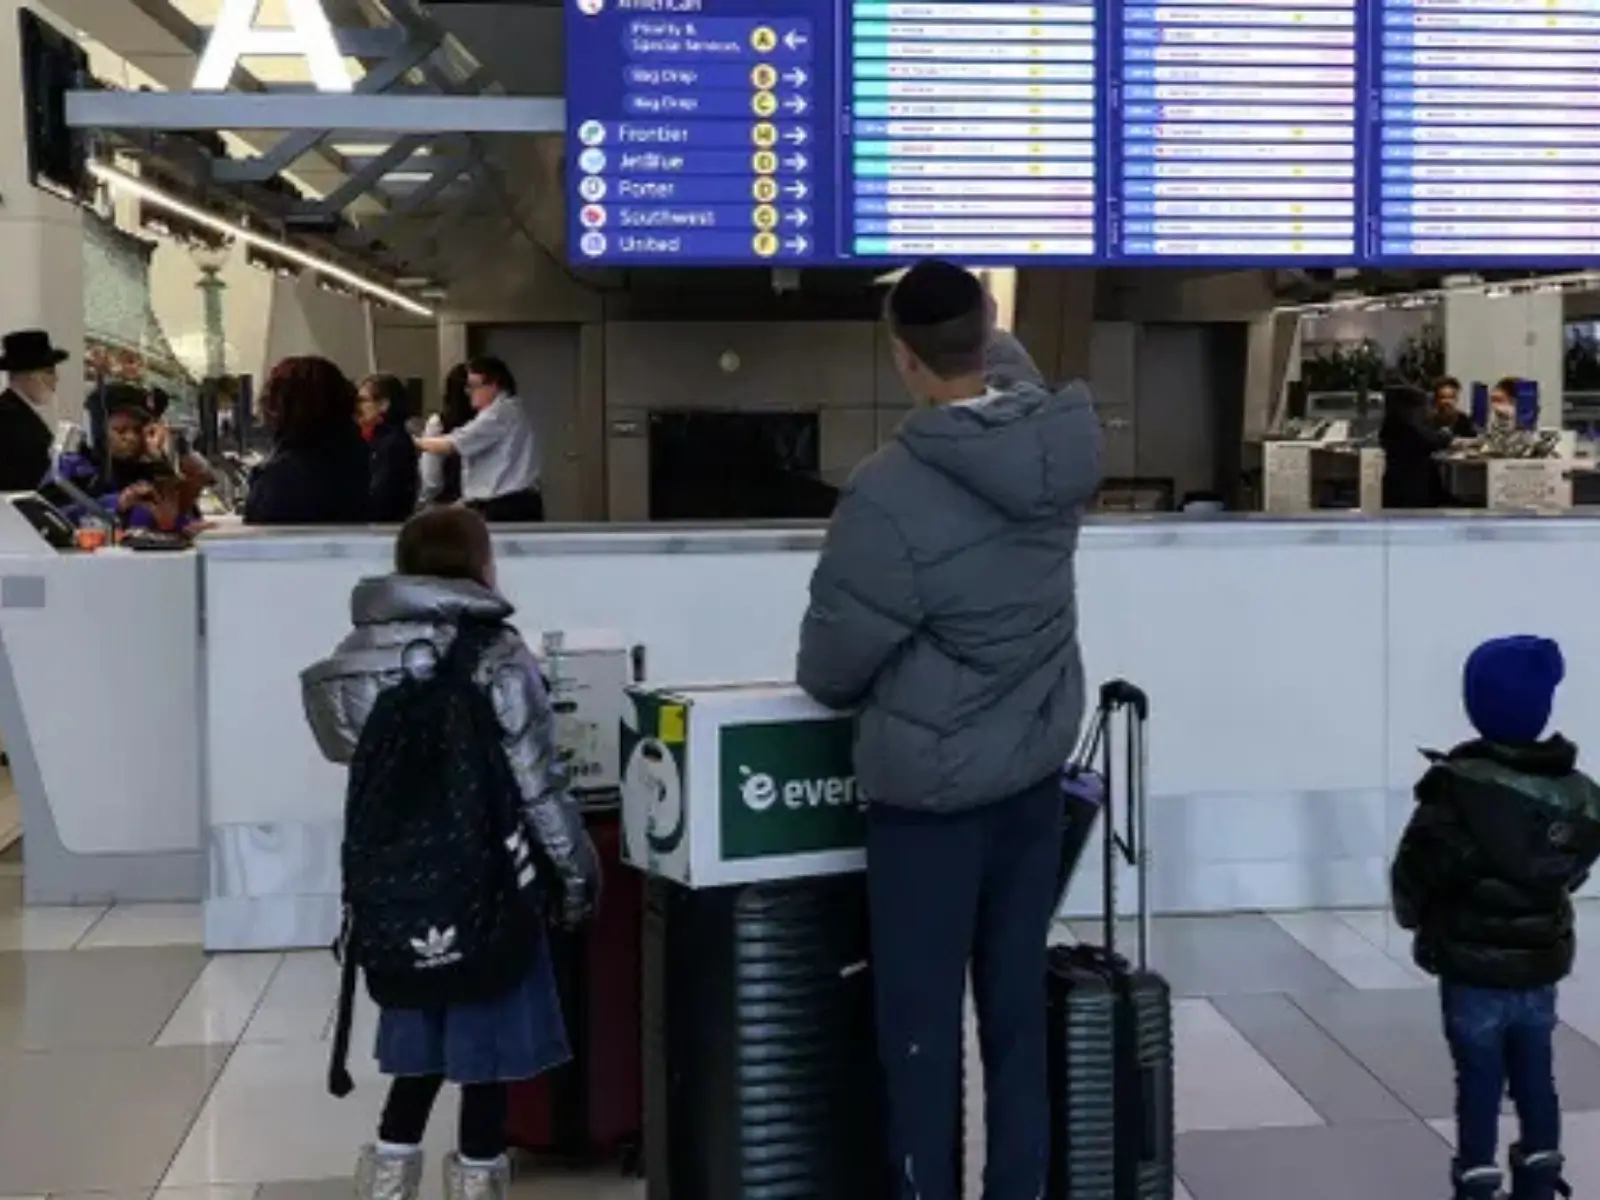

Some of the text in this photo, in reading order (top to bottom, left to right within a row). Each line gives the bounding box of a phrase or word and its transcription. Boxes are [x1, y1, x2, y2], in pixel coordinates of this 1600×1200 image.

[192, 0, 353, 92] A
[619, 125, 688, 142] Frontier
[620, 153, 683, 171] JetBlue
[619, 208, 716, 226] Southwest
[619, 235, 680, 252] United
